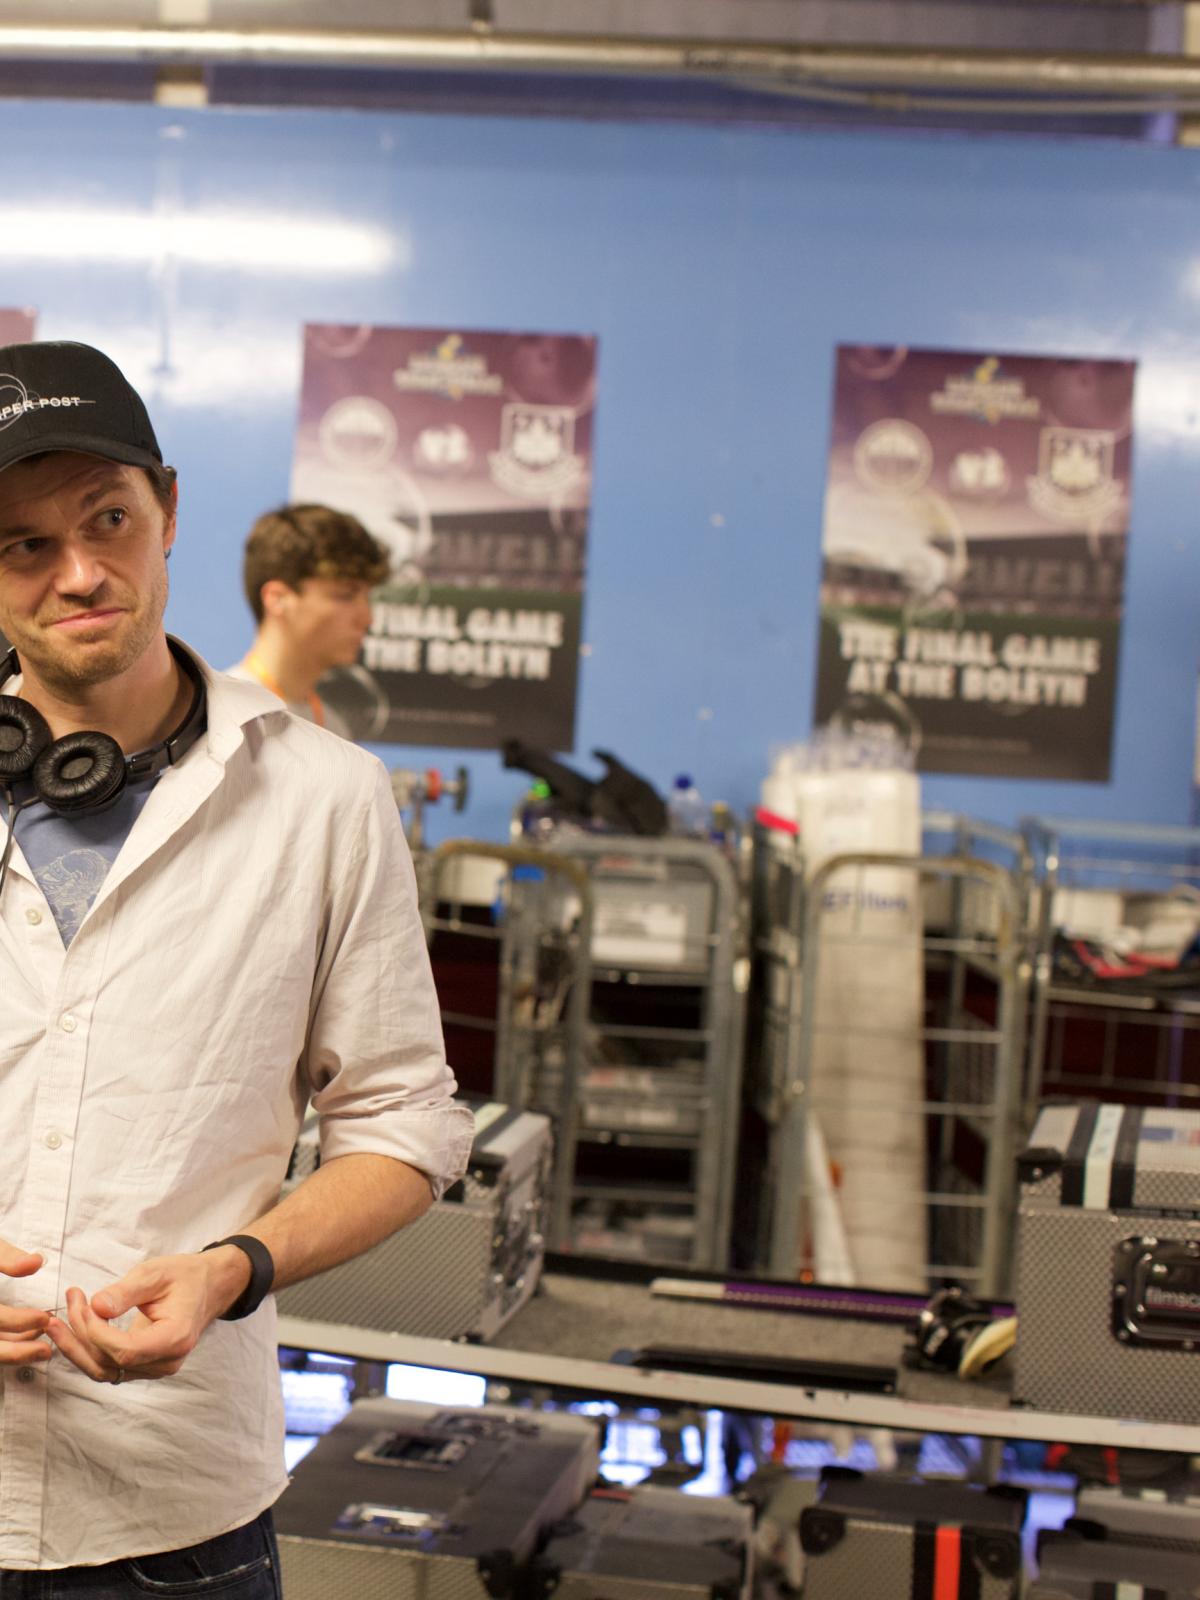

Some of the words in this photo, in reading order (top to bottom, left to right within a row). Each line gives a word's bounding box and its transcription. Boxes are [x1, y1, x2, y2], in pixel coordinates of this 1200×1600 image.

[39, 396, 82, 409] POST
[466, 606, 564, 648] GAME
[839, 620, 897, 661] THE
[904, 626, 997, 667] FINAL
[1002, 633, 1100, 674] GAME
[427, 639, 550, 681] BOLEYN
[847, 660, 891, 694] AT
[897, 660, 955, 699] THE
[960, 665, 1087, 706] BOLEYN
